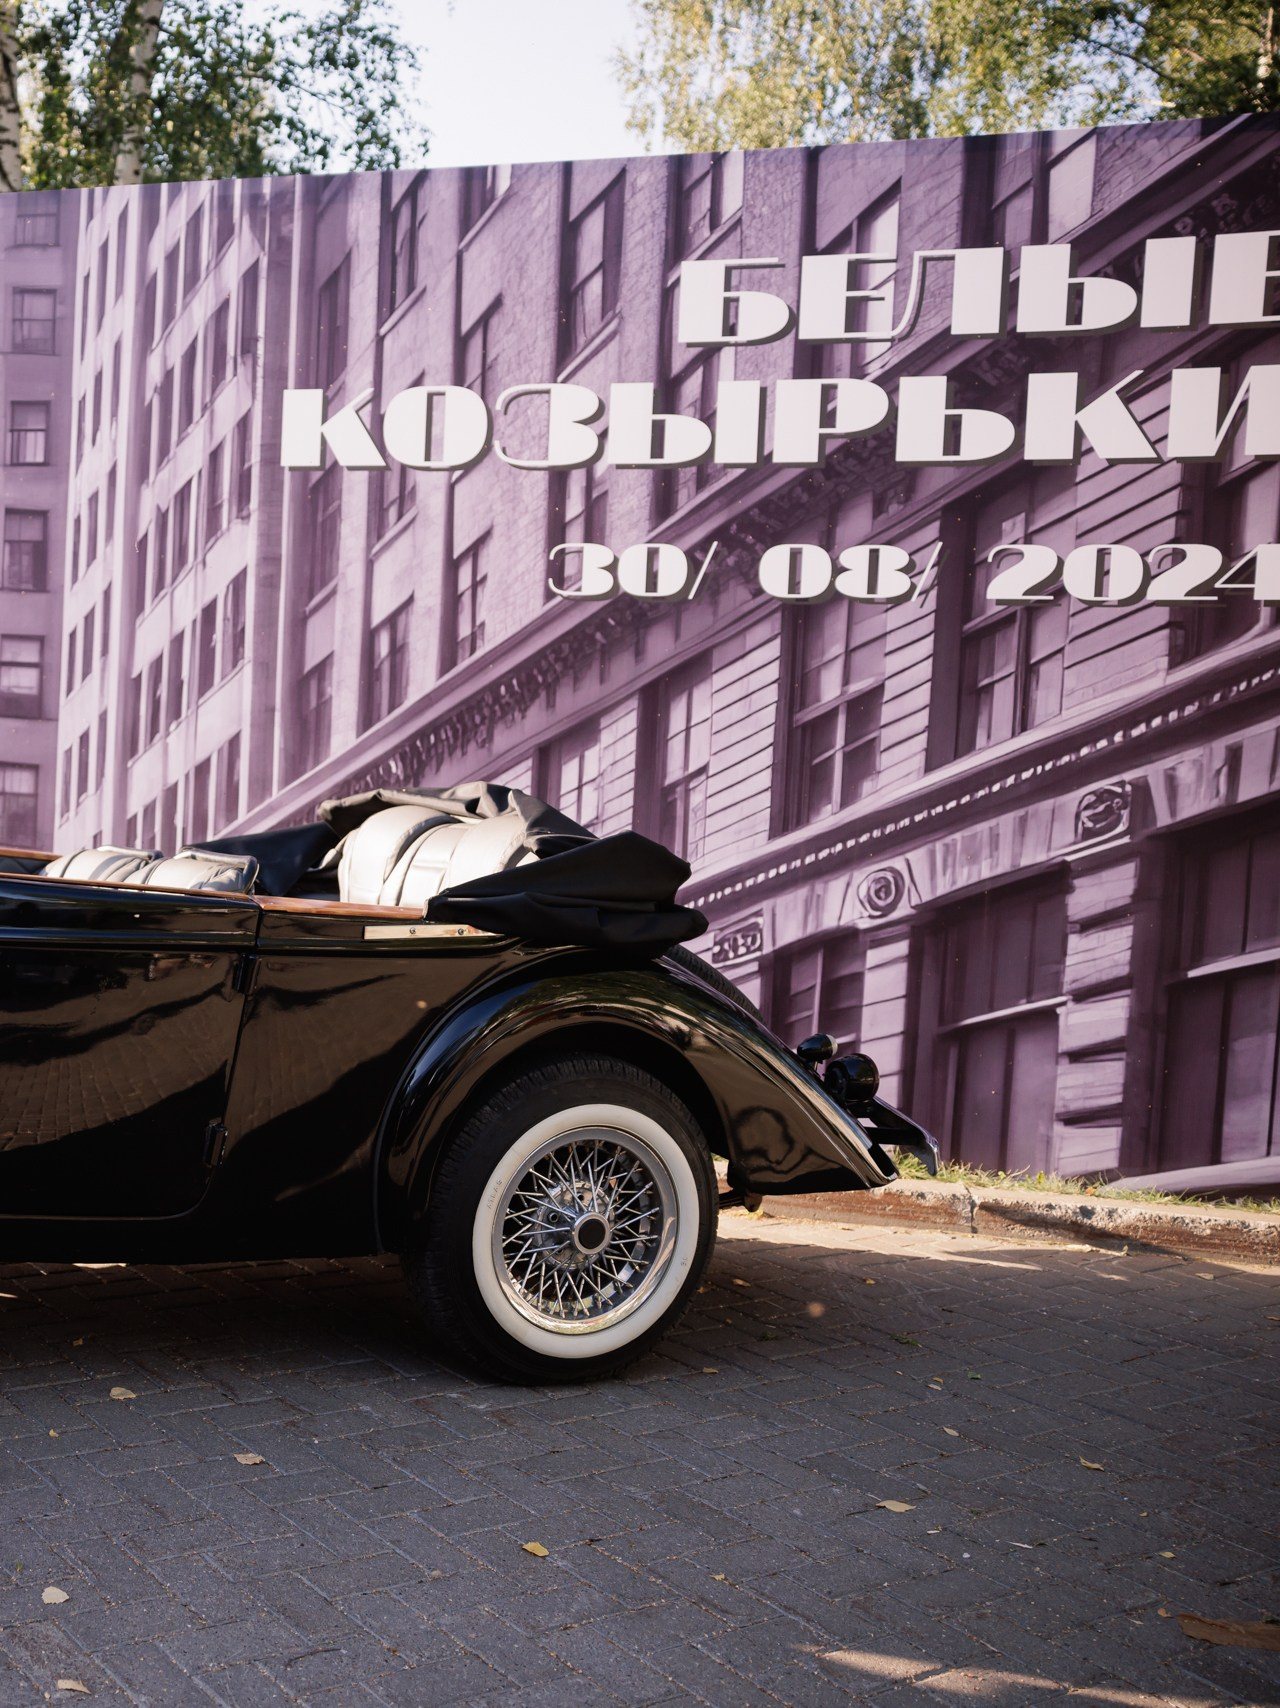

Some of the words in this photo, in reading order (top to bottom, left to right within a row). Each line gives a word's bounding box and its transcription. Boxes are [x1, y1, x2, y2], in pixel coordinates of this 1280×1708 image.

[677, 230, 1280, 346] БЕЛЫЕ
[280, 363, 1280, 469] КОЗЫРЬКИ
[548, 541, 718, 600] 30/
[758, 541, 944, 602] 08/
[985, 542, 1280, 602] 2024
